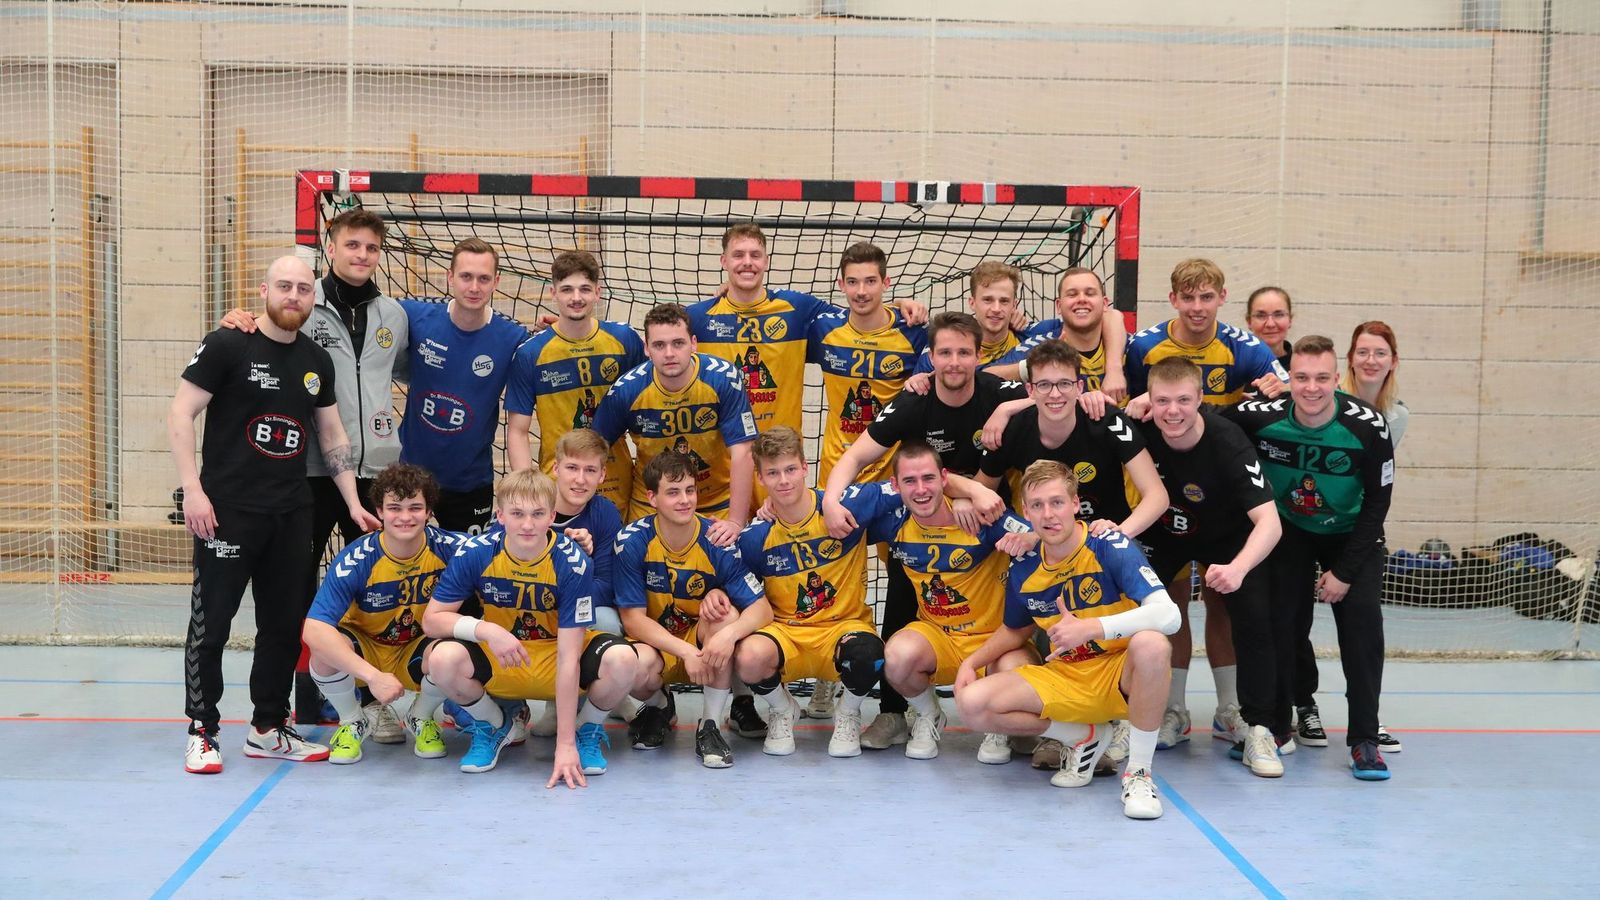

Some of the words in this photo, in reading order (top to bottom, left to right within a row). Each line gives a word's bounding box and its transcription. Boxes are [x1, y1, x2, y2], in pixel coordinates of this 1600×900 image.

[737, 316, 762, 343] 23
[474, 360, 491, 370] HSG
[577, 357, 592, 385] 8
[602, 363, 617, 375] HSG
[851, 349, 876, 378] 21
[883, 361, 902, 372] HSG
[661, 407, 692, 437] 30
[696, 411, 715, 425] HSG
[1296, 446, 1321, 472] 12
[791, 543, 817, 571] 13
[821, 543, 841, 556] HSG
[926, 545, 940, 573] 2
[951, 555, 970, 567] HSG
[399, 577, 420, 604] 31
[513, 582, 537, 610] 71
[1081, 585, 1099, 597] HSG
